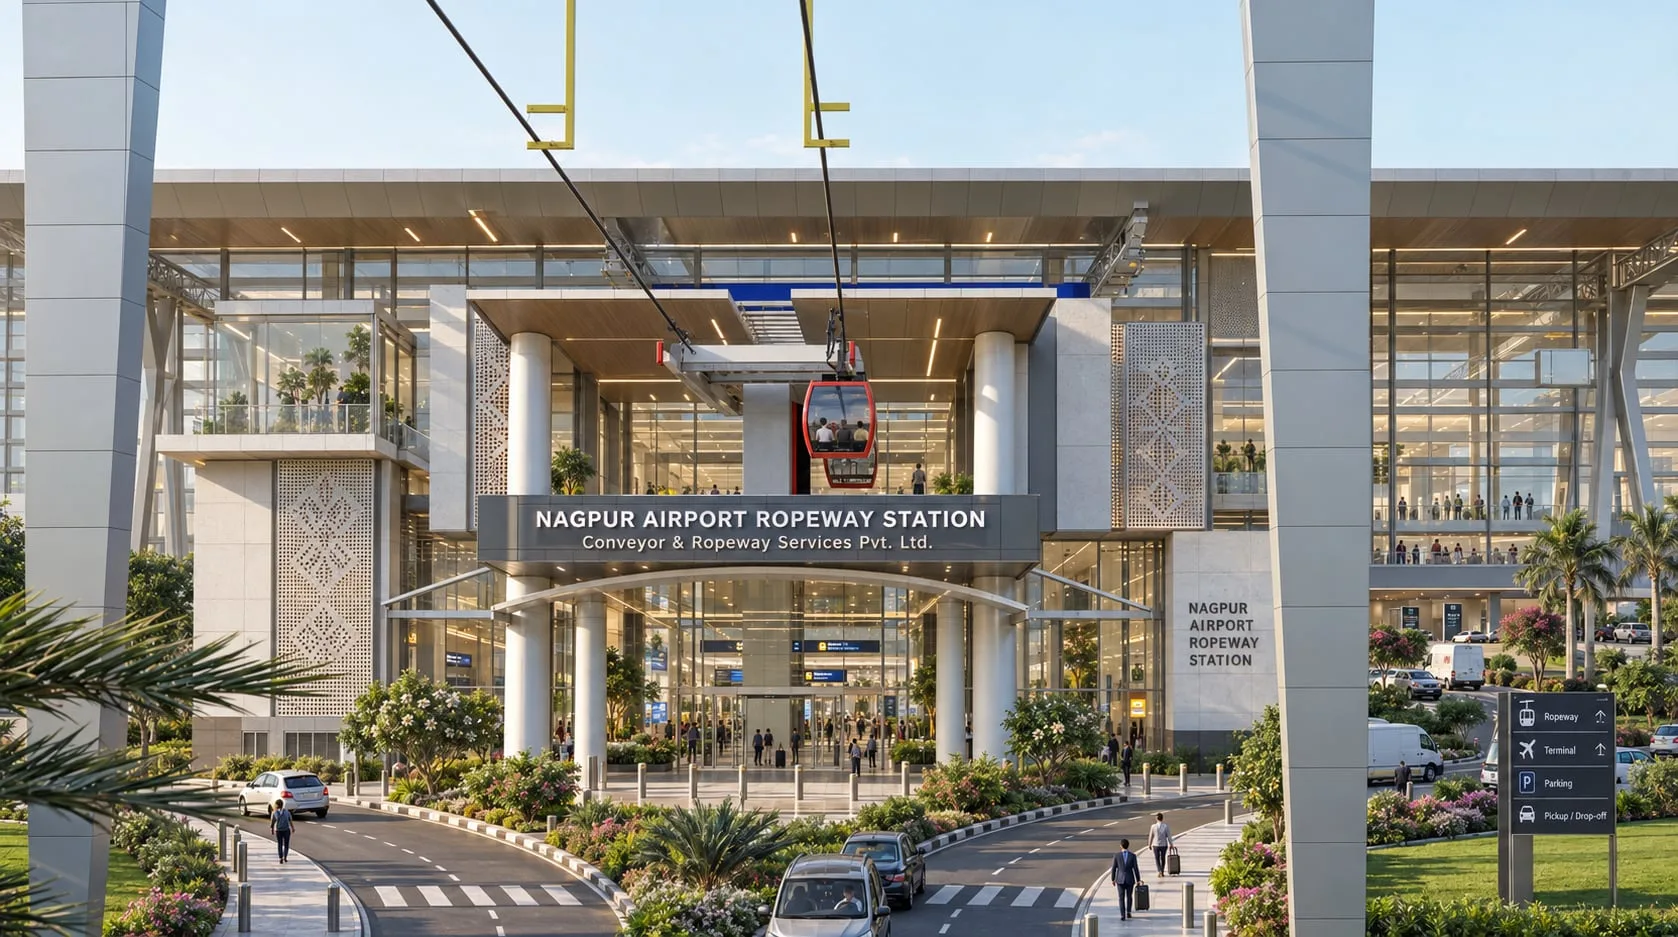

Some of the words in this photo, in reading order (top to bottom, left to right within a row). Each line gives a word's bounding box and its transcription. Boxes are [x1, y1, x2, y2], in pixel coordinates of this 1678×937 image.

[536, 510, 635, 528] NAGPUR
[642, 510, 748, 528] AIRPORT
[756, 510, 874, 528] ROPEWAY
[882, 510, 985, 528] STATION
[582, 535, 666, 552] Conveyor
[672, 535, 684, 549] &
[692, 535, 771, 552] Ropeway
[778, 535, 852, 549] Services
[859, 535, 892, 549] Pvt.
[900, 535, 933, 549] Ltd.
[1188, 602, 1248, 615] NAGPUR
[1189, 619, 1254, 632] AIRPORT
[1189, 636, 1259, 649] ROPEWAY
[1189, 654, 1252, 667] STATION
[1544, 712, 1579, 723] Ropeway
[1544, 745, 1576, 755] Terminal
[1523, 775, 1531, 789] P
[1544, 778, 1573, 790] Parking
[1544, 811, 1569, 822] Pickup
[1575, 811, 1608, 822] Drop-off
